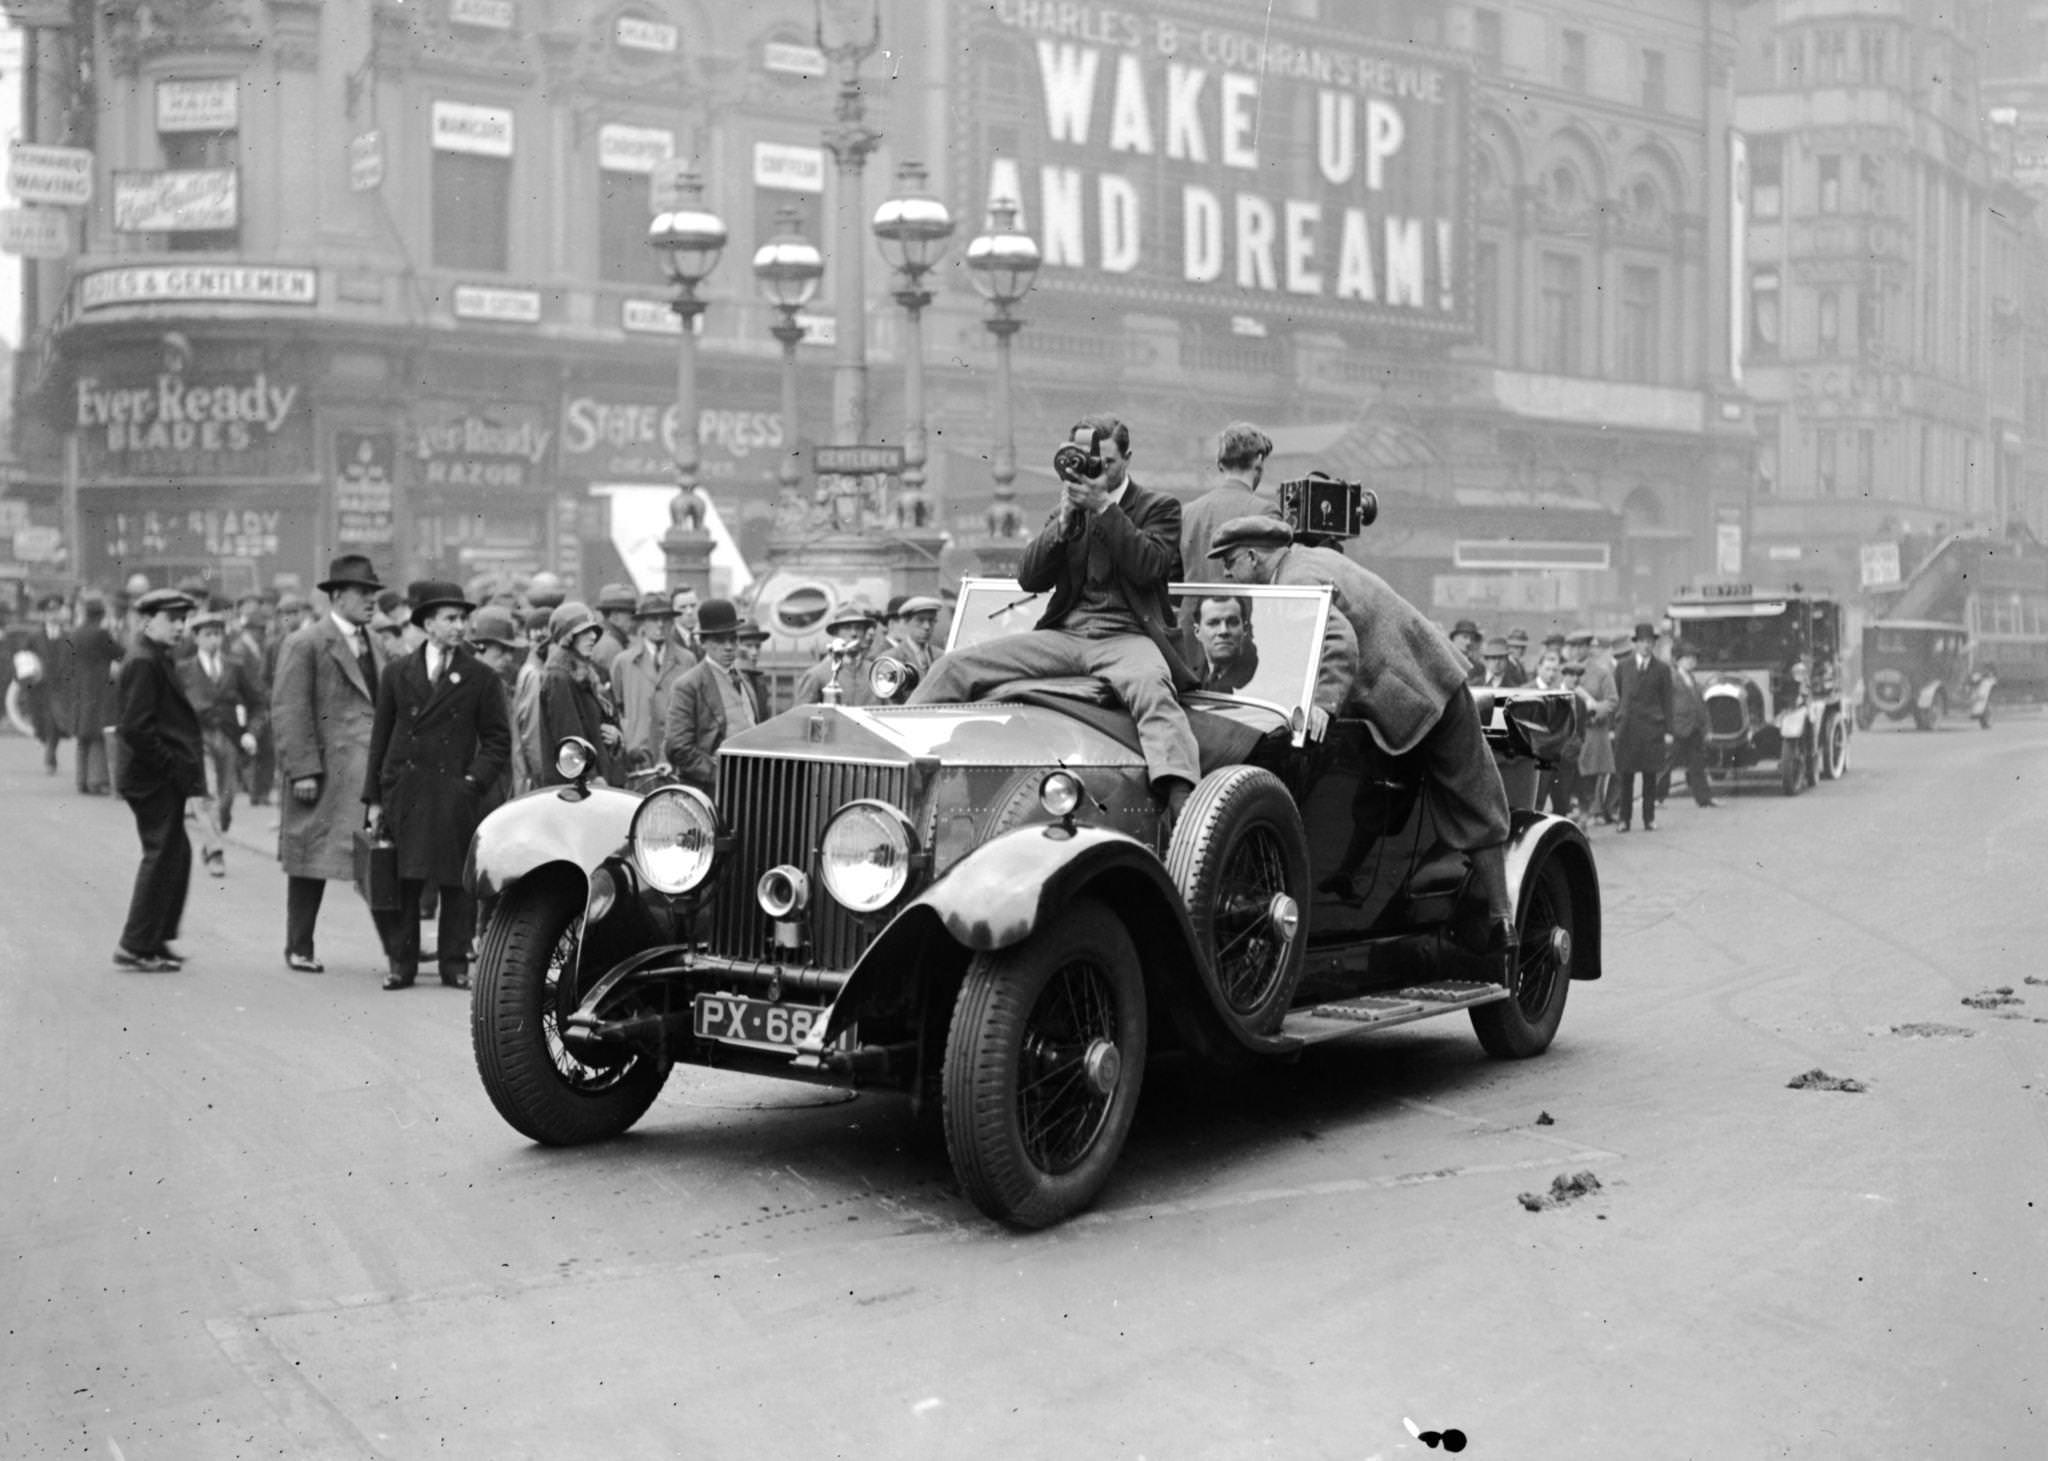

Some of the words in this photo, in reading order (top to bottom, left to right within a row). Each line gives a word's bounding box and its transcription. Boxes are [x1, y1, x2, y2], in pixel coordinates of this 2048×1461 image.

[998, 0, 1141, 47] CHARLES
[1358, 56, 1445, 104] REVUE
[1035, 38, 1259, 169] WAKE
[1317, 87, 1404, 191] UP
[15, 172, 87, 196] WAVING
[984, 157, 1141, 273] AND
[1182, 184, 1454, 312] DREAM!
[167, 271, 306, 294] GENTLEMEN
[107, 421, 249, 452] BLADES
[564, 398, 659, 453] STATE
[660, 402, 785, 458] EPRESS
